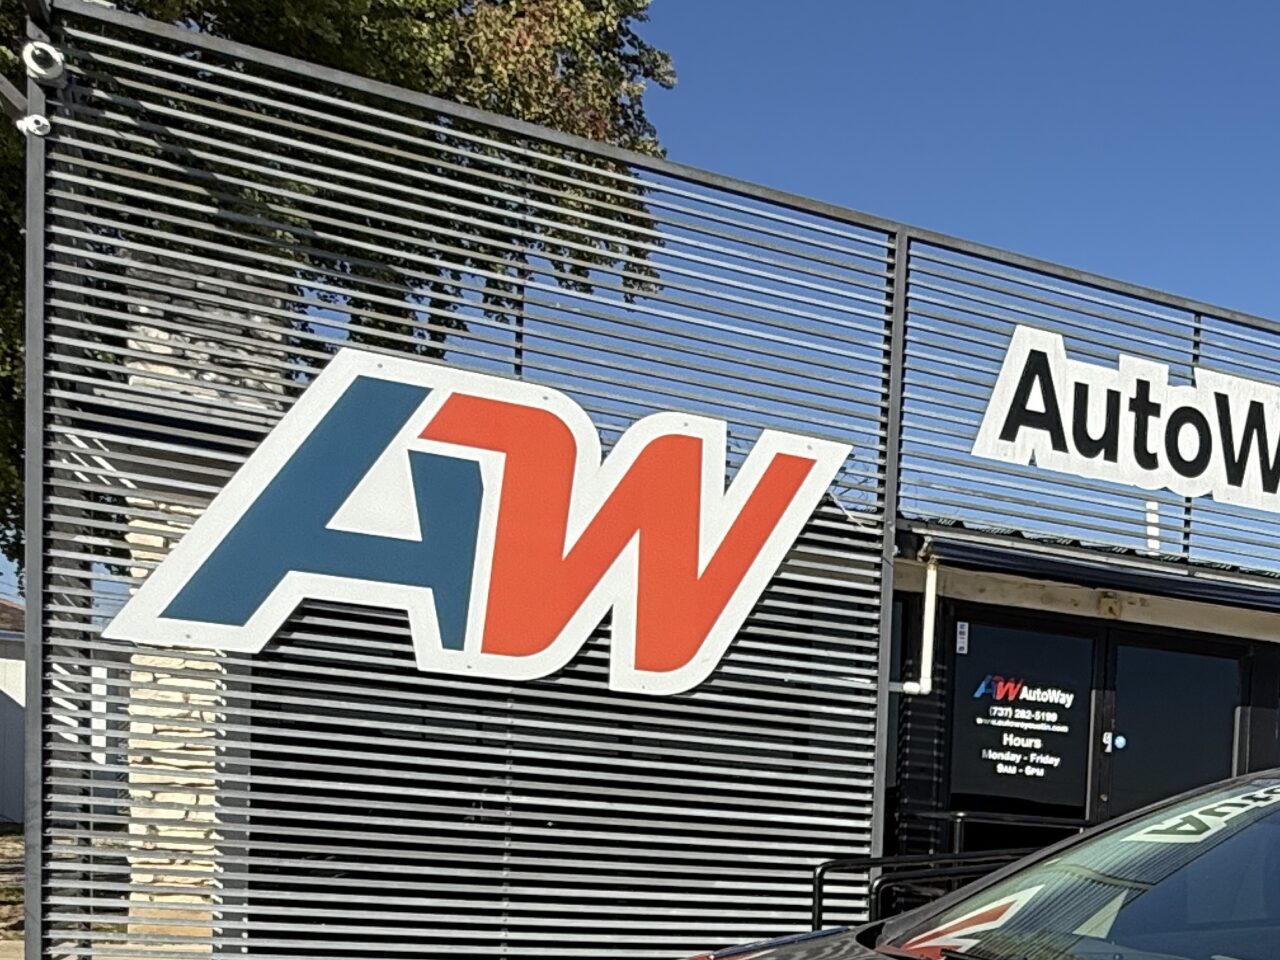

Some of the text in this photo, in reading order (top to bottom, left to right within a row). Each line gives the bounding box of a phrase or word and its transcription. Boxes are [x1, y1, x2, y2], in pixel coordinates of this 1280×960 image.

[156, 373, 818, 674] AW
[973, 674, 1074, 708] AW AutoWay
[1002, 733, 1042, 749] Hours
[982, 749, 1022, 763] Monday
[1030, 753, 1061, 767] Friday
